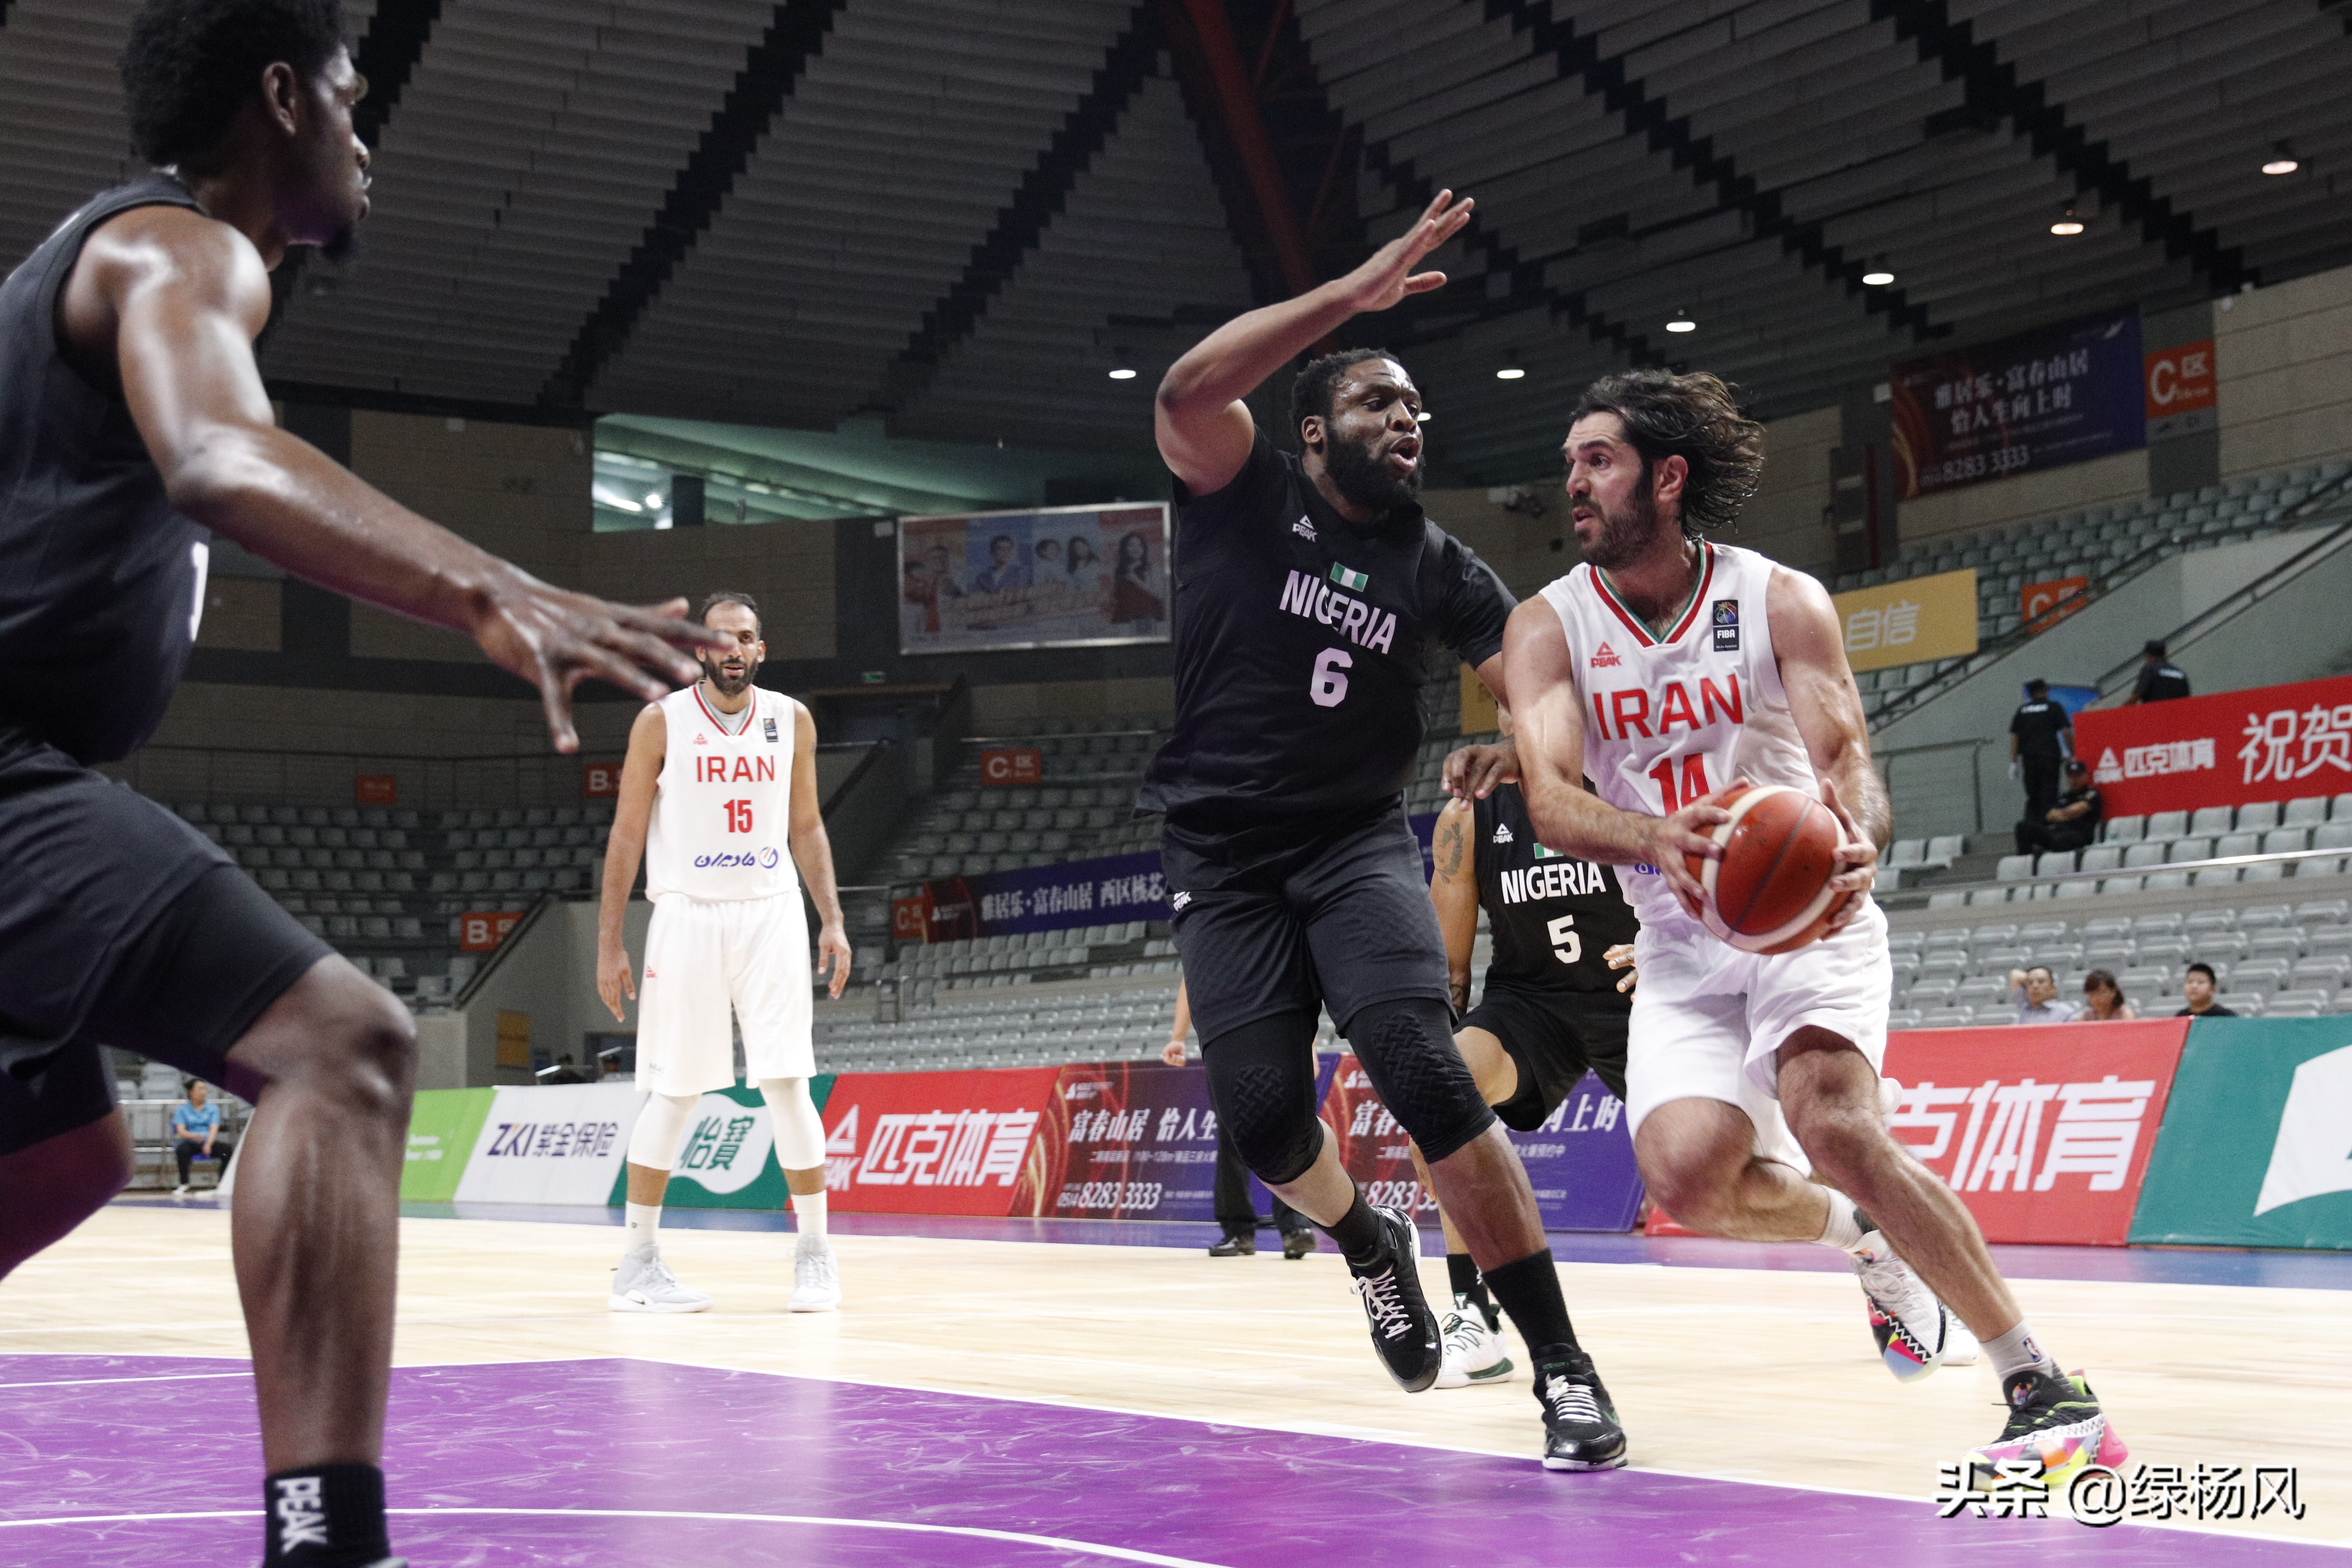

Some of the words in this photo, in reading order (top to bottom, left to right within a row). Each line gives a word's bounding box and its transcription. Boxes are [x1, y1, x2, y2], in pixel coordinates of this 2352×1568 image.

[1992, 444, 2030, 472] 3333
[1292, 523, 1318, 543] PEAK
[1279, 569, 1397, 655] NIGERIA
[1844, 599, 1920, 652] 自信
[1717, 629, 1735, 639] FIBA
[1310, 647, 1353, 707] 6
[1591, 655, 1622, 668] PEAK
[1593, 673, 1744, 740] IRAN
[2237, 704, 2352, 785] 祝贺
[696, 755, 775, 782] IRAN
[1649, 753, 1710, 817] 14
[723, 799, 753, 833] 15
[1493, 833, 1514, 844] PEAK
[1501, 862, 1606, 904] NIGERIA
[1174, 891, 1192, 912] PEAK
[1547, 915, 1582, 964] 5
[534, 1122, 619, 1156] 紫金保险
[680, 1115, 755, 1171] 怡寶
[1068, 1108, 1151, 1143] 富春山居
[856, 1108, 1040, 1187] 匹克体育
[1078, 1181, 1122, 1209] 8283
[1120, 1181, 1162, 1210] 3333
[1366, 1180, 1419, 1210] 8283
[276, 1476, 328, 1555] PEAK
